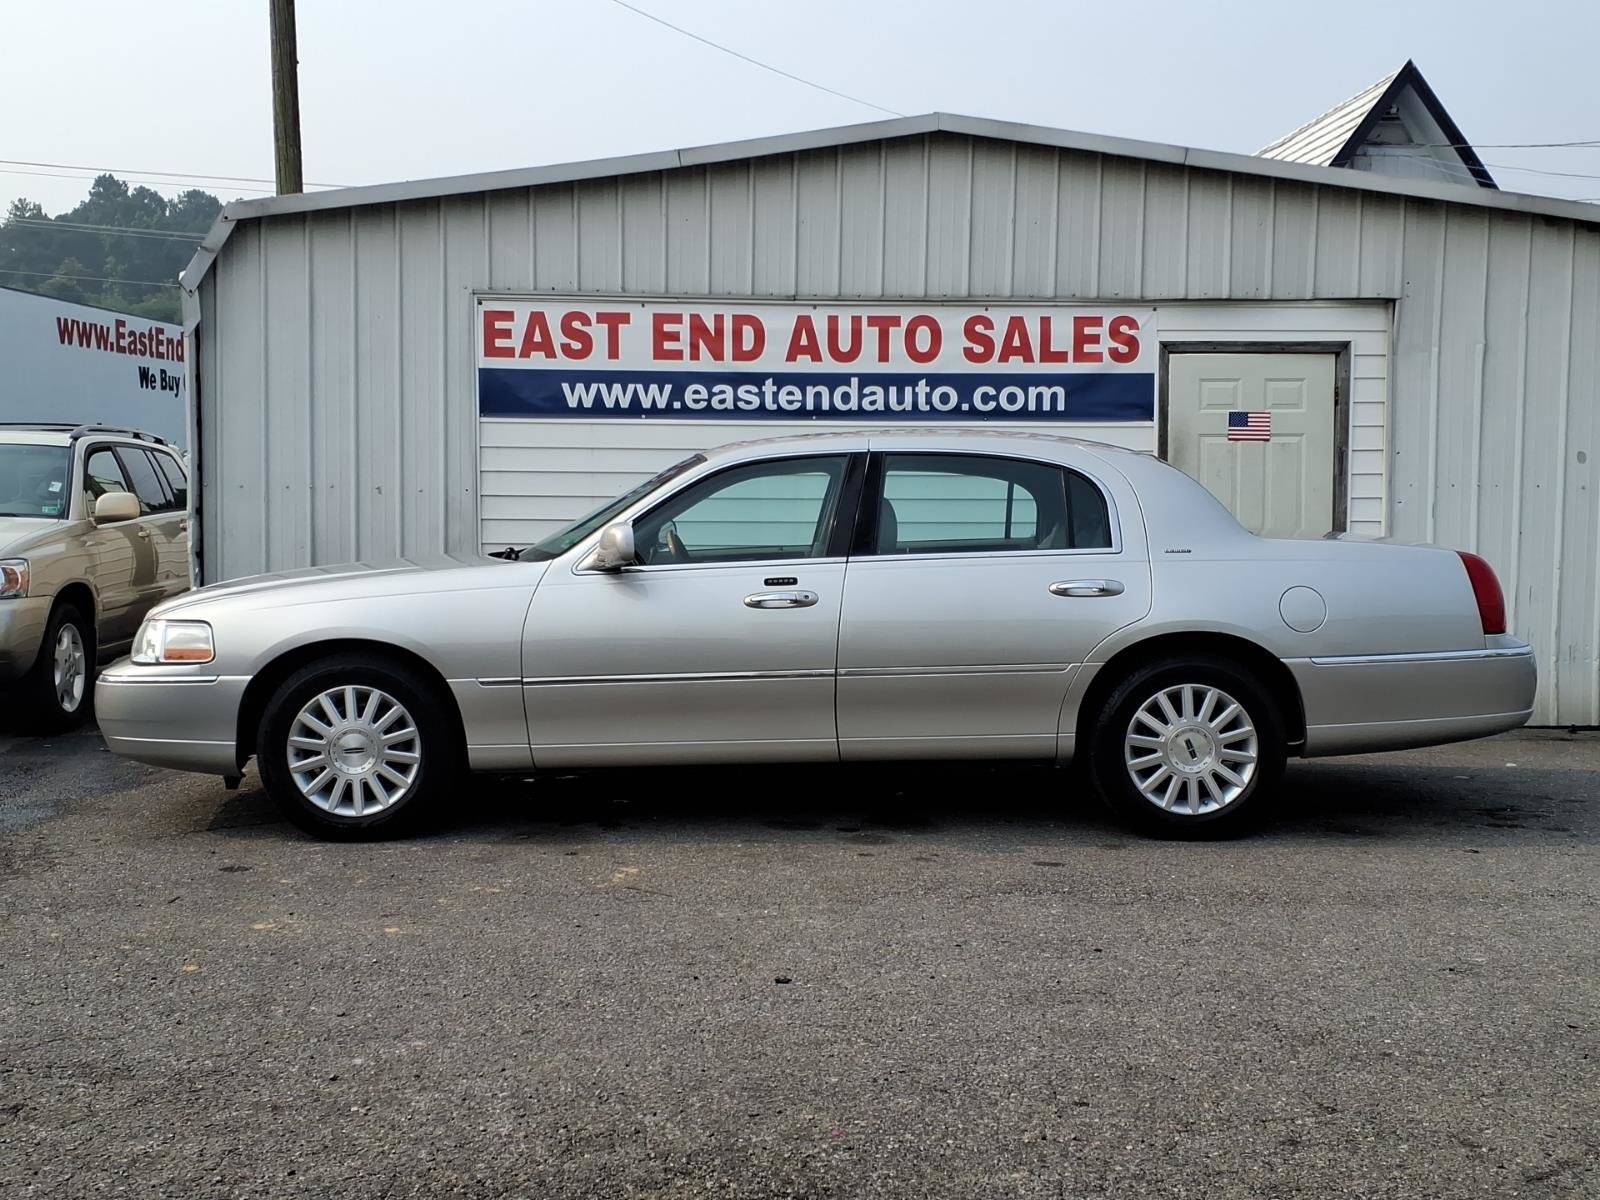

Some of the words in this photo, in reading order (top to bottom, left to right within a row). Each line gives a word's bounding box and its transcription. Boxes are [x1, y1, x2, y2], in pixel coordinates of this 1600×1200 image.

[483, 310, 631, 360] EAST
[652, 313, 766, 362] END
[785, 314, 943, 364] AUTO
[962, 315, 1141, 364] SALES
[138, 366, 157, 390] We
[160, 369, 181, 398] Buy
[561, 376, 1066, 412] www.eastendauto.com
